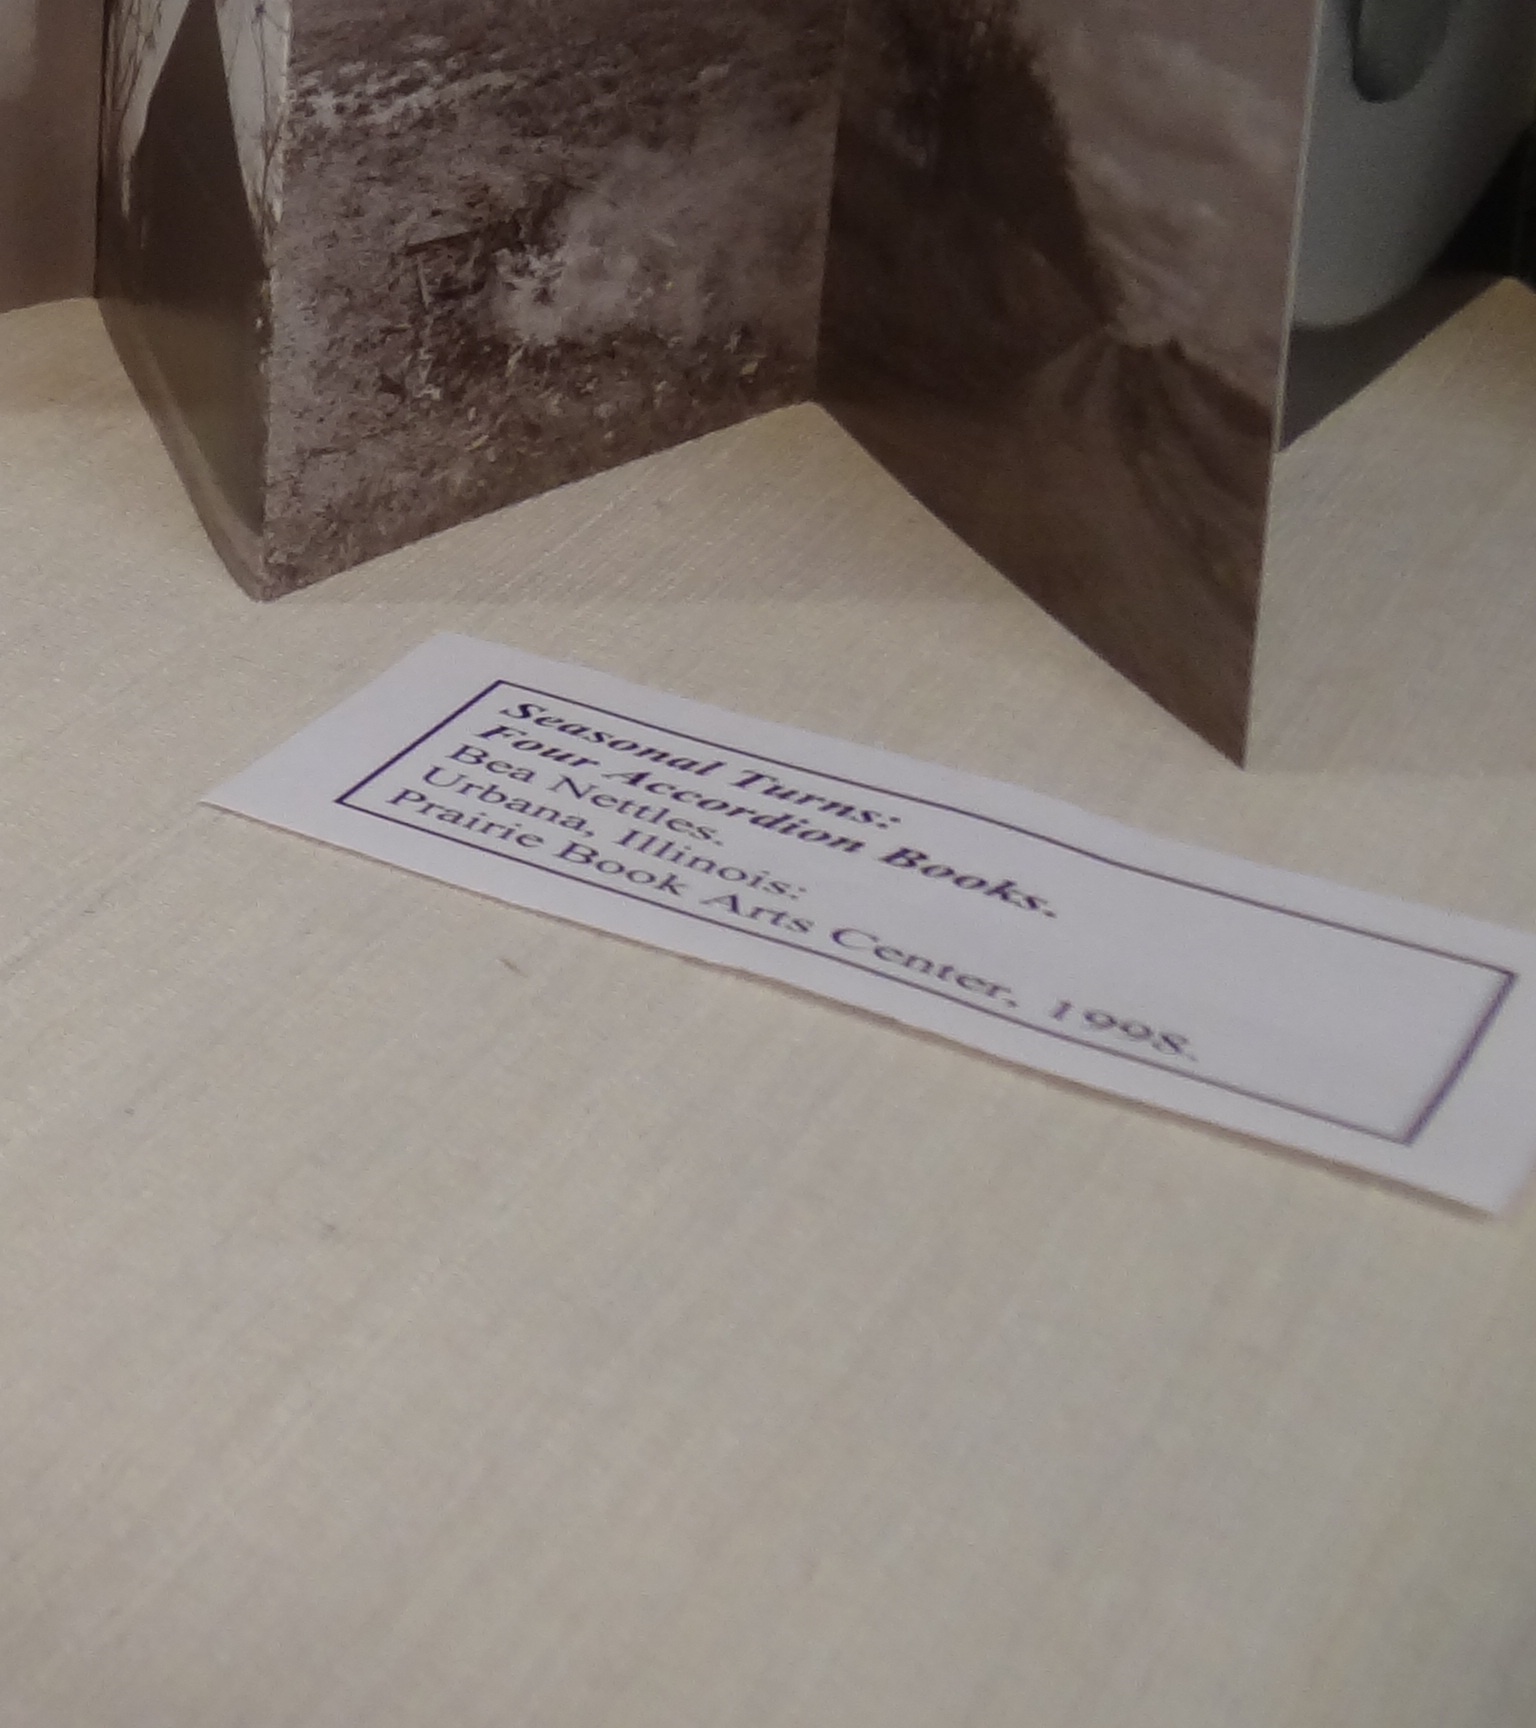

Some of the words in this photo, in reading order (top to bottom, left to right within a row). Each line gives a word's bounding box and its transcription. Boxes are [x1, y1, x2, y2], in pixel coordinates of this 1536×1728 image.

[422, 765, 596, 839] Urbana,
[611, 829, 808, 901] Illinois:
[445, 743, 534, 783] Bea
[546, 774, 726, 847] Nettles.
[472, 724, 601, 771] Four
[601, 770, 867, 854] Accordion
[878, 845, 1059, 919] Books.
[499, 702, 726, 777] Seasonal
[731, 769, 902, 830] Turns:
[384, 787, 545, 850] Prairie
[552, 839, 693, 898] Book
[698, 893, 817, 936] Arts
[829, 926, 1021, 1009] Center,
